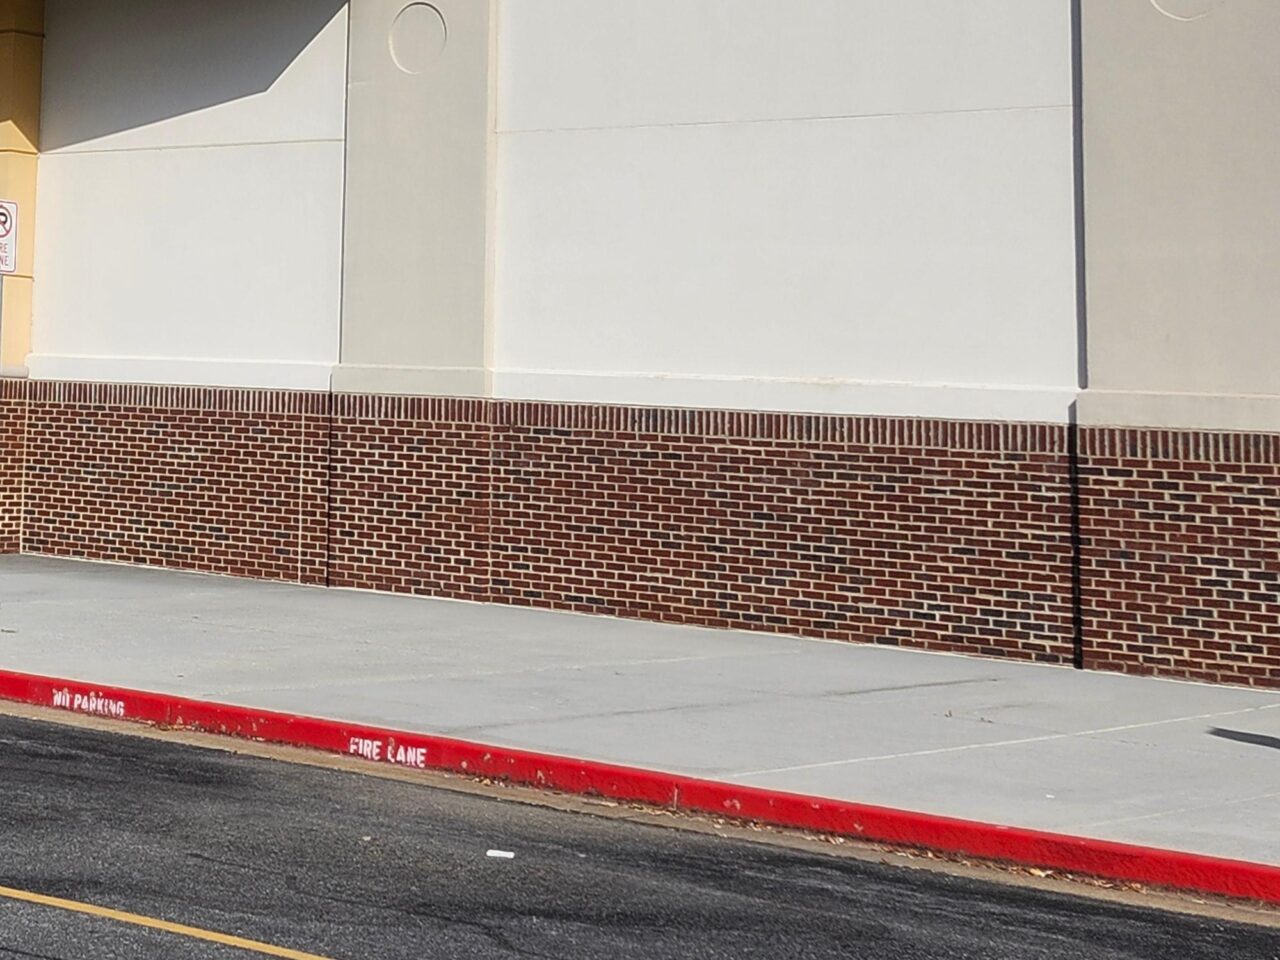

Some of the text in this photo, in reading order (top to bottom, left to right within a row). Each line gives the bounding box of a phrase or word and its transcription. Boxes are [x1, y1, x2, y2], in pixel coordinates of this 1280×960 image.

[74, 692, 125, 717] PARKING
[349, 736, 427, 769] FIRE LANE
